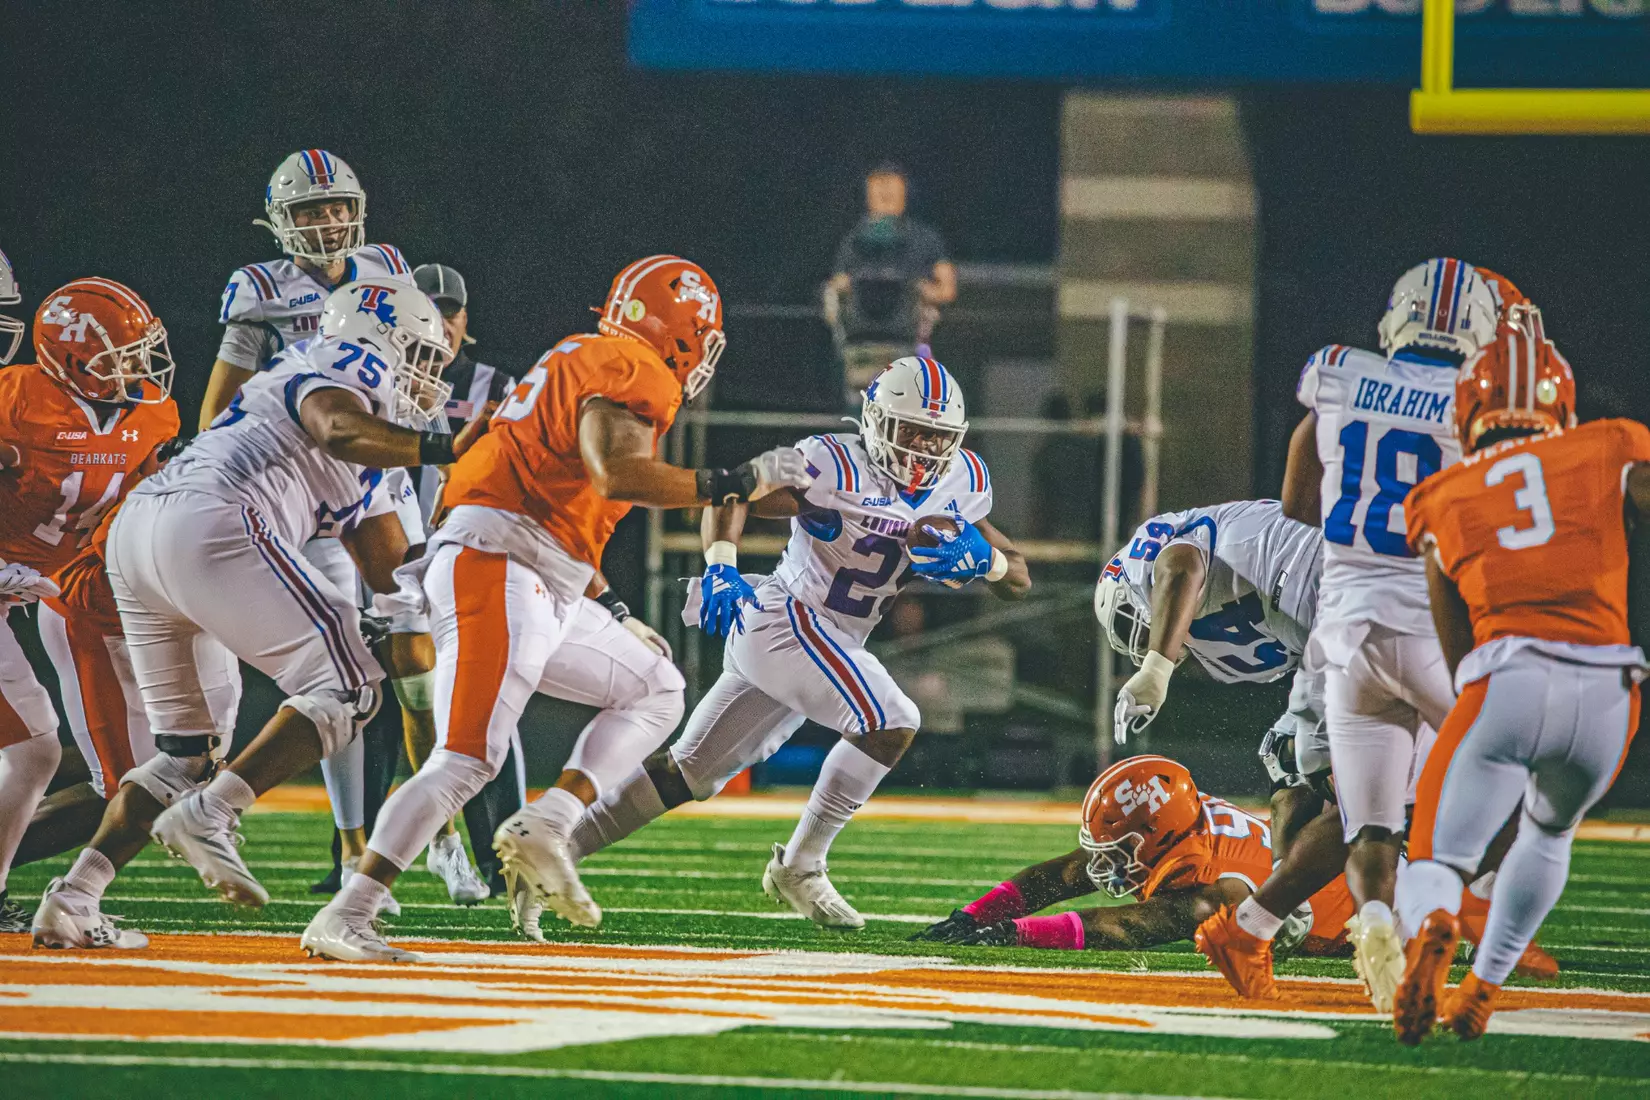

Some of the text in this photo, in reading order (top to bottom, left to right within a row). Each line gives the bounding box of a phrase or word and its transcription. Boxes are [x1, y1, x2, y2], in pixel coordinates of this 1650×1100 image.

[219, 281, 239, 320] 7
[292, 314, 321, 332] LOU
[330, 341, 388, 389] 75
[1354, 377, 1450, 424] IBRAHIM
[70, 452, 127, 465] BEARKATS
[1324, 420, 1443, 557] 18
[1485, 453, 1555, 550] 3
[823, 534, 901, 619] 2
